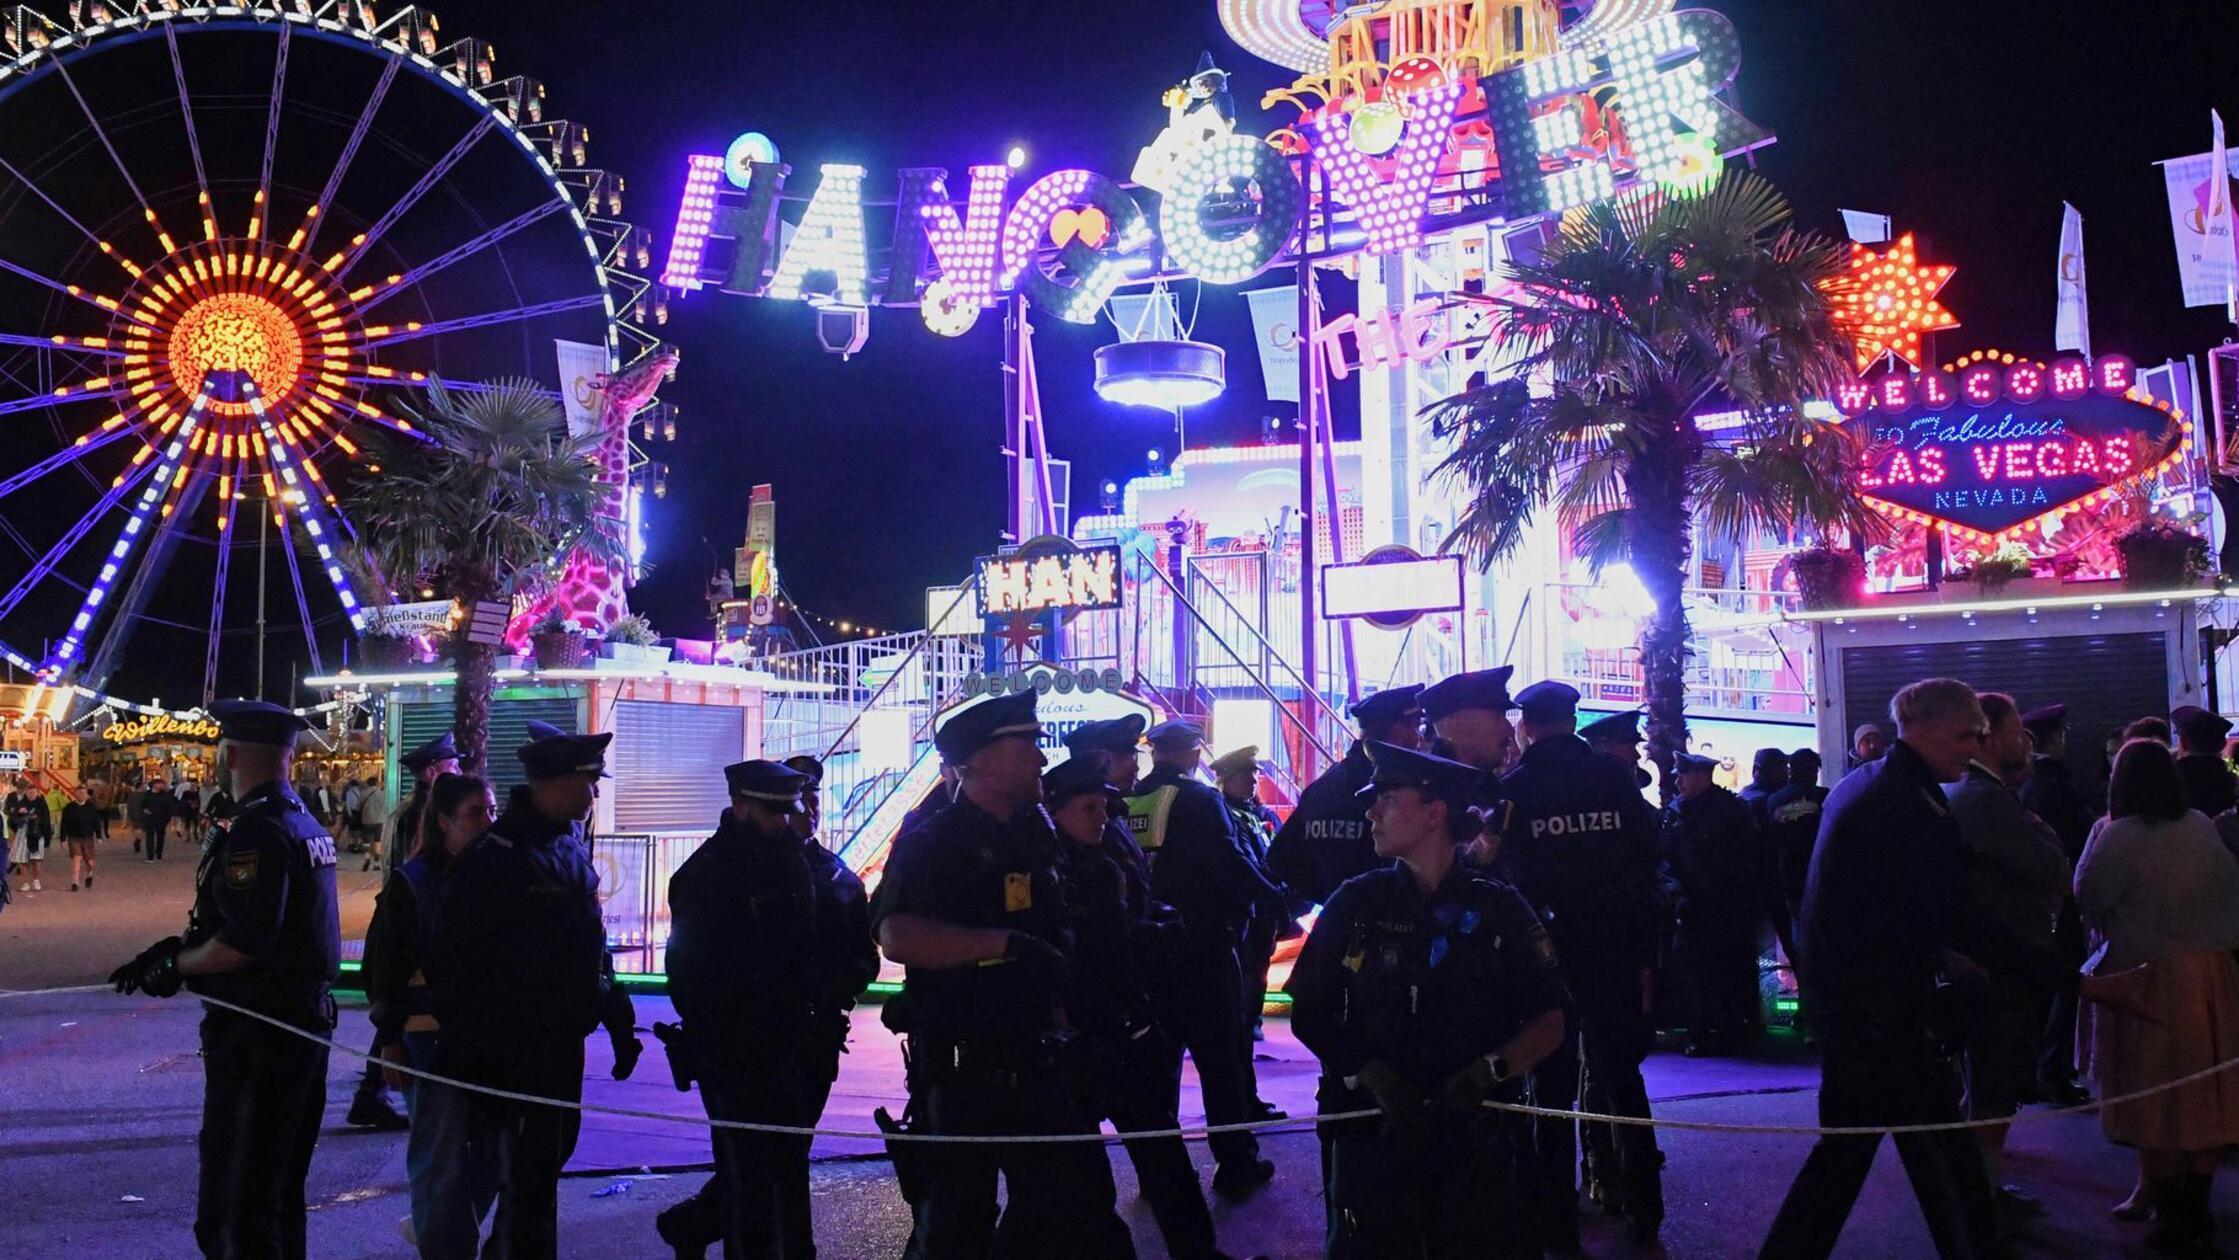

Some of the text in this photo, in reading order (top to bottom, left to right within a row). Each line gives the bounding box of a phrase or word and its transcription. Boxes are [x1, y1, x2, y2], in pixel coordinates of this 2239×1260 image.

[663, 7, 1777, 325] HANGOVER
[1838, 360, 2126, 409] WELCOME
[1910, 412, 2066, 450] Fabulous
[1860, 436, 2132, 486] LAS VEGAS
[1935, 486, 2048, 509] NEVADA
[987, 552, 1112, 612] HAN
[966, 673, 1117, 692] WELCOME
[103, 713, 219, 741] Willenbo
[1304, 819, 1364, 840] POLIZEI
[1531, 810, 1622, 839] POLIZEI
